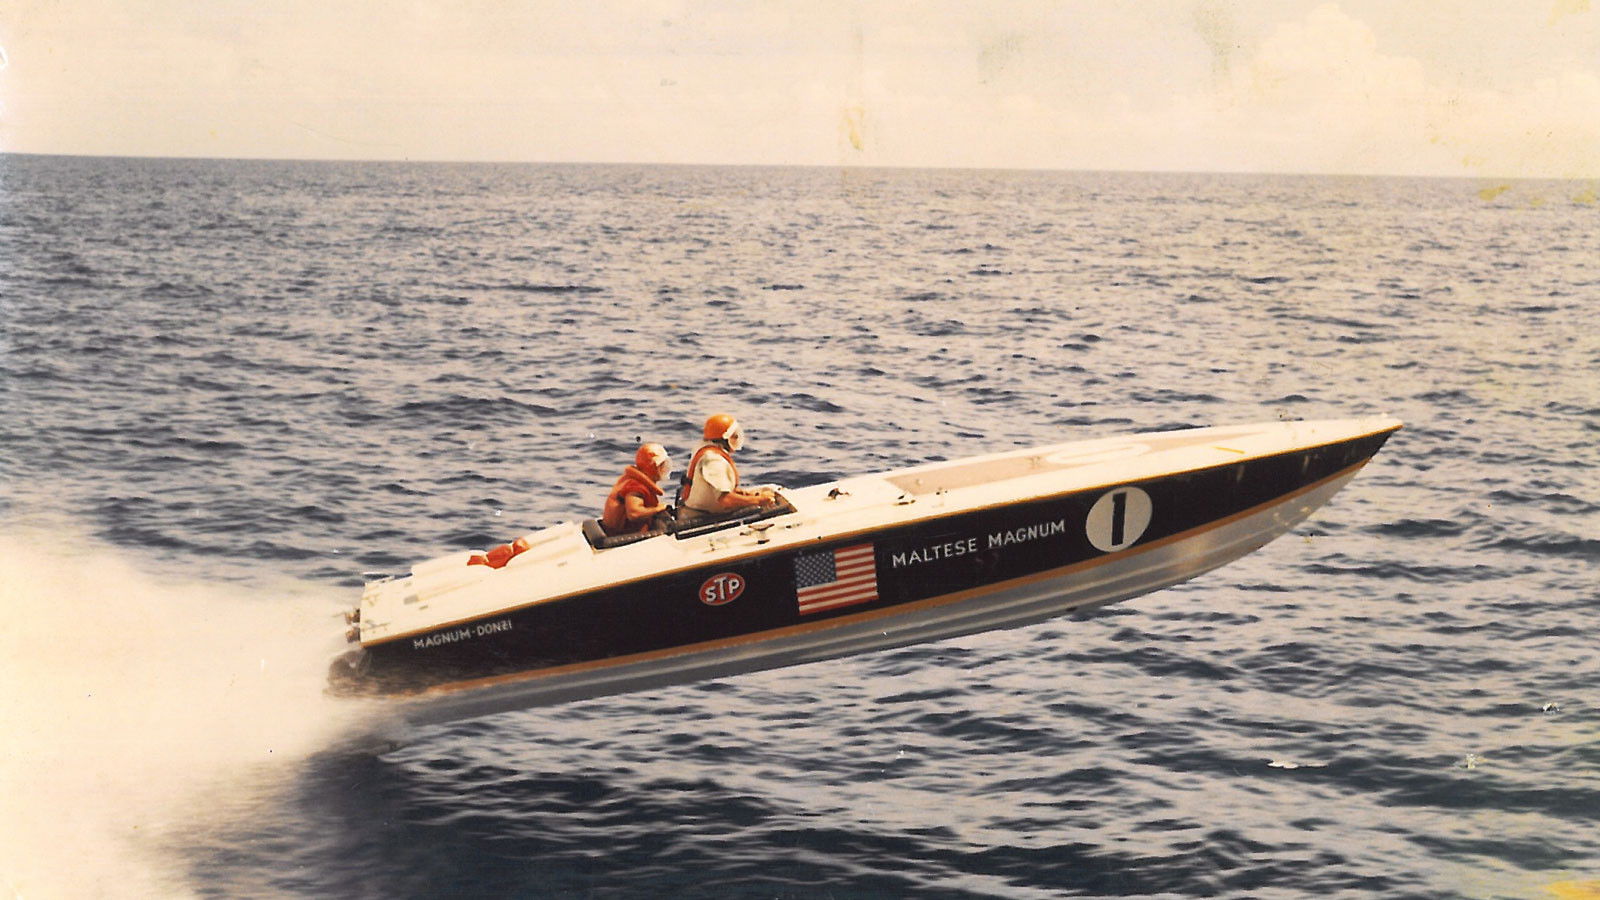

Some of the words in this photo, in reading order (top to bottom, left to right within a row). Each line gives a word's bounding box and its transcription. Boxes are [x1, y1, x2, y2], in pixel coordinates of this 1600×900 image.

[1111, 491, 1127, 546] 1
[891, 538, 978, 568] MALTESE
[988, 519, 1066, 549] MAGNUM
[704, 576, 740, 602] STP
